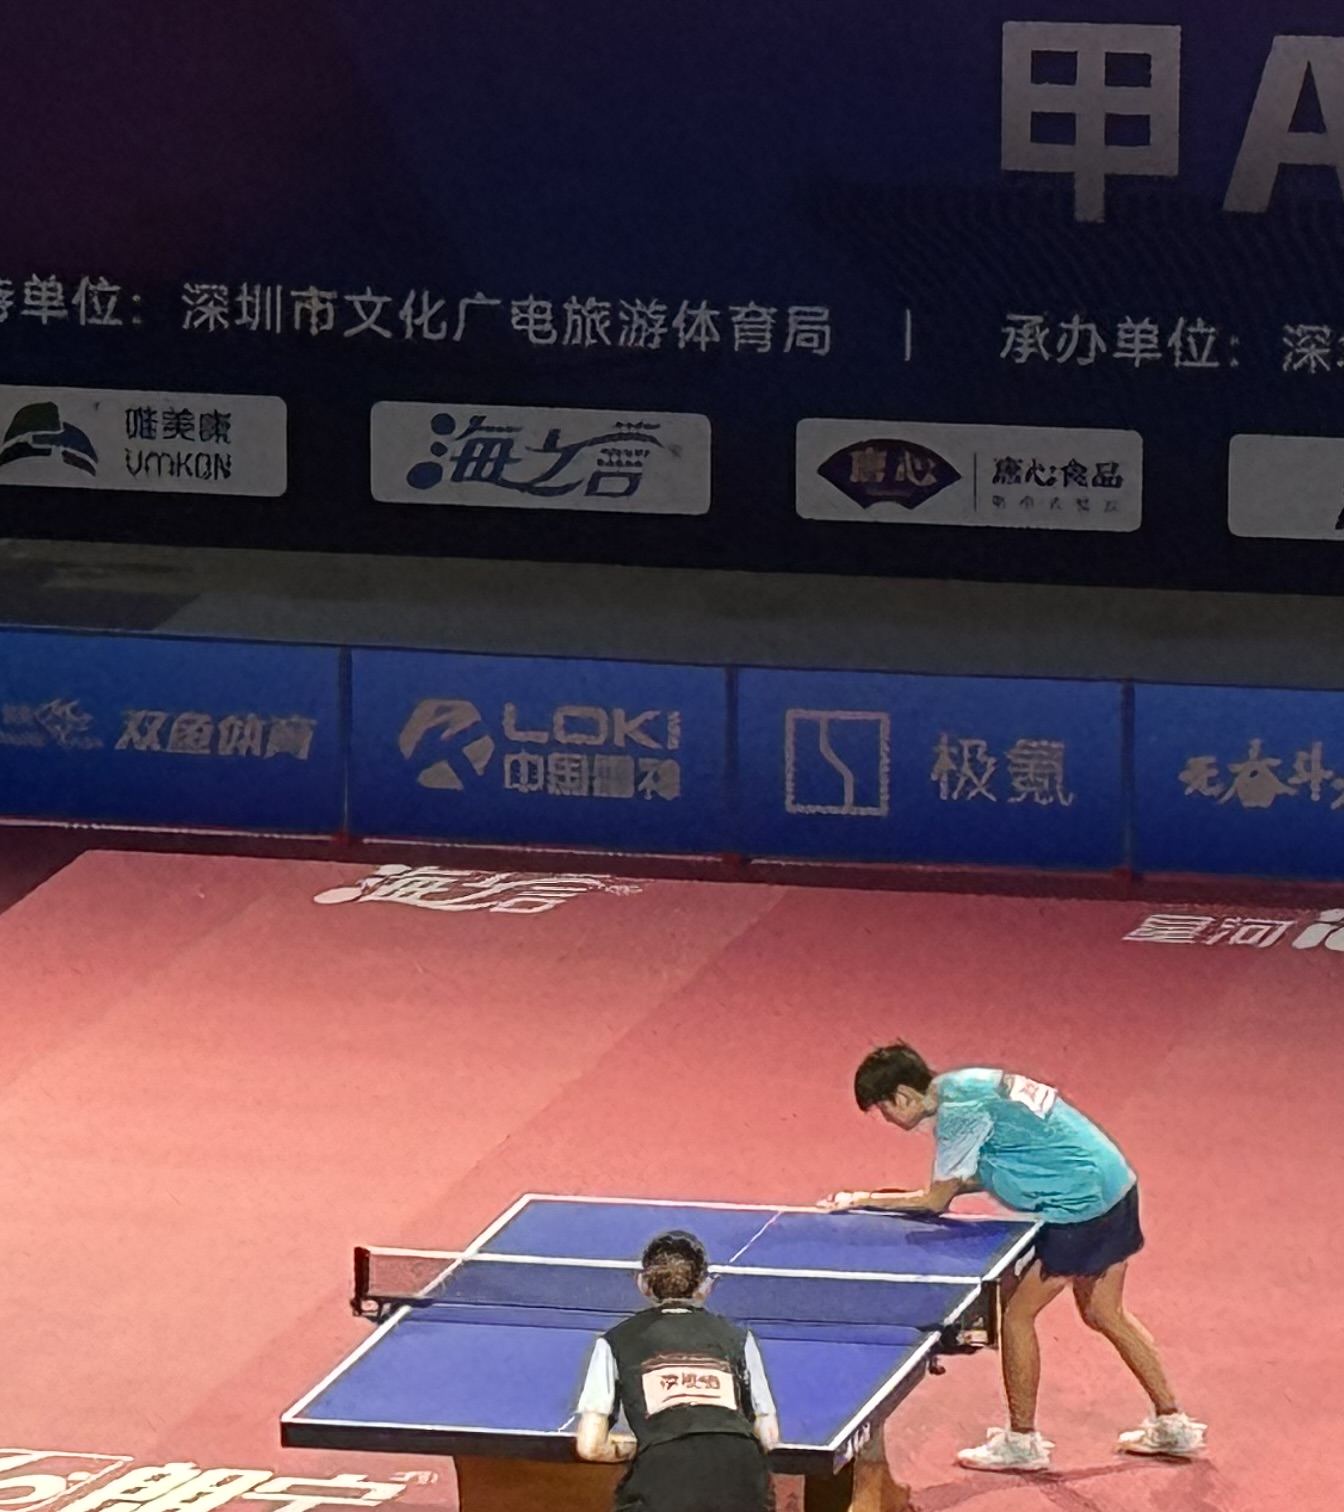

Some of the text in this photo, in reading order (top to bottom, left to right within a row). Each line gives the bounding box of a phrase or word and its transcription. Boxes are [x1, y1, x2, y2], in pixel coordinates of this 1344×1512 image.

[181, 282, 832, 357] 深圳市文化广电旅游体育局
[999, 313, 1240, 369] 承办单位：
[501, 701, 681, 751] LOKI
[929, 730, 1075, 807] 极氪
